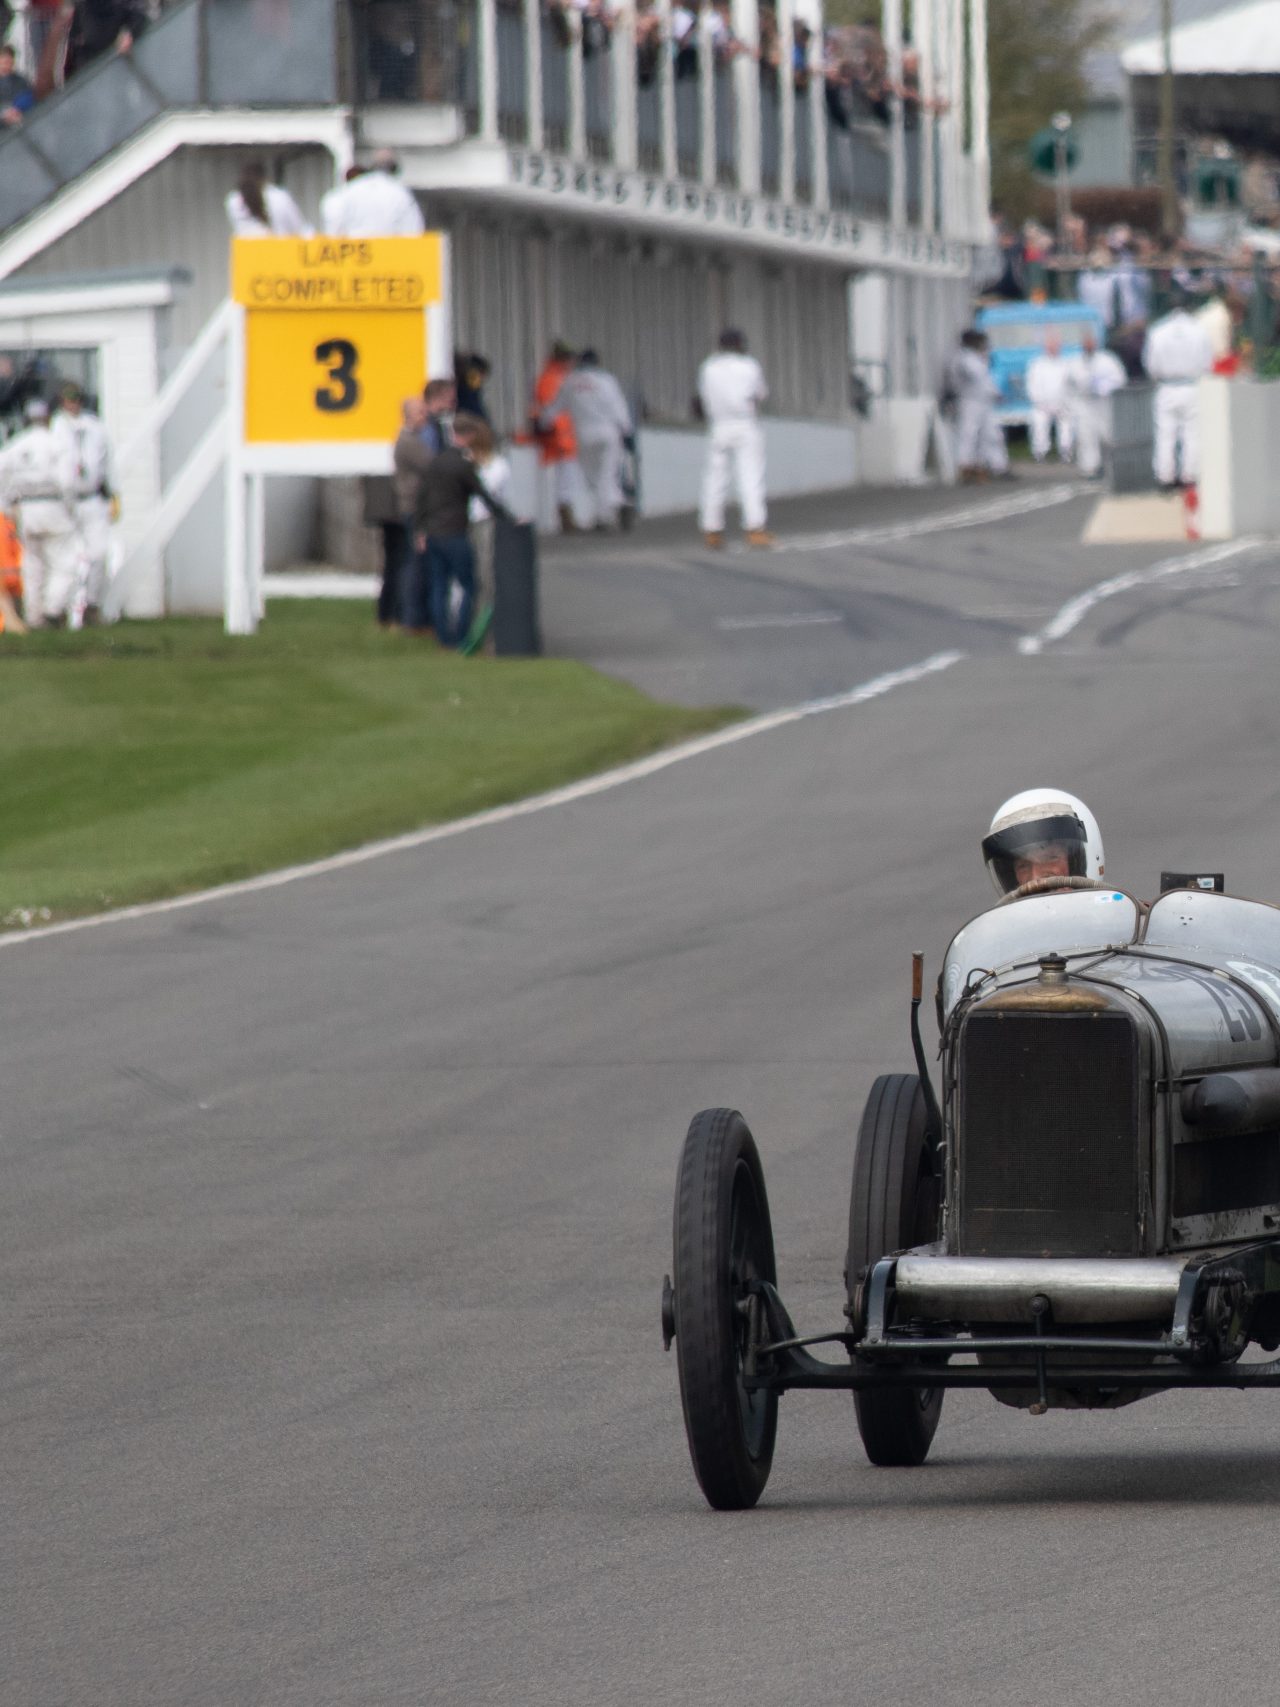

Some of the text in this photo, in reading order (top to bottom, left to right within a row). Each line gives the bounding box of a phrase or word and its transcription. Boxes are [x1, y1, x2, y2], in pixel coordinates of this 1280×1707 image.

[302, 242, 373, 268] LAPS
[251, 275, 424, 302] COMPLETED
[314, 338, 359, 413] 3
